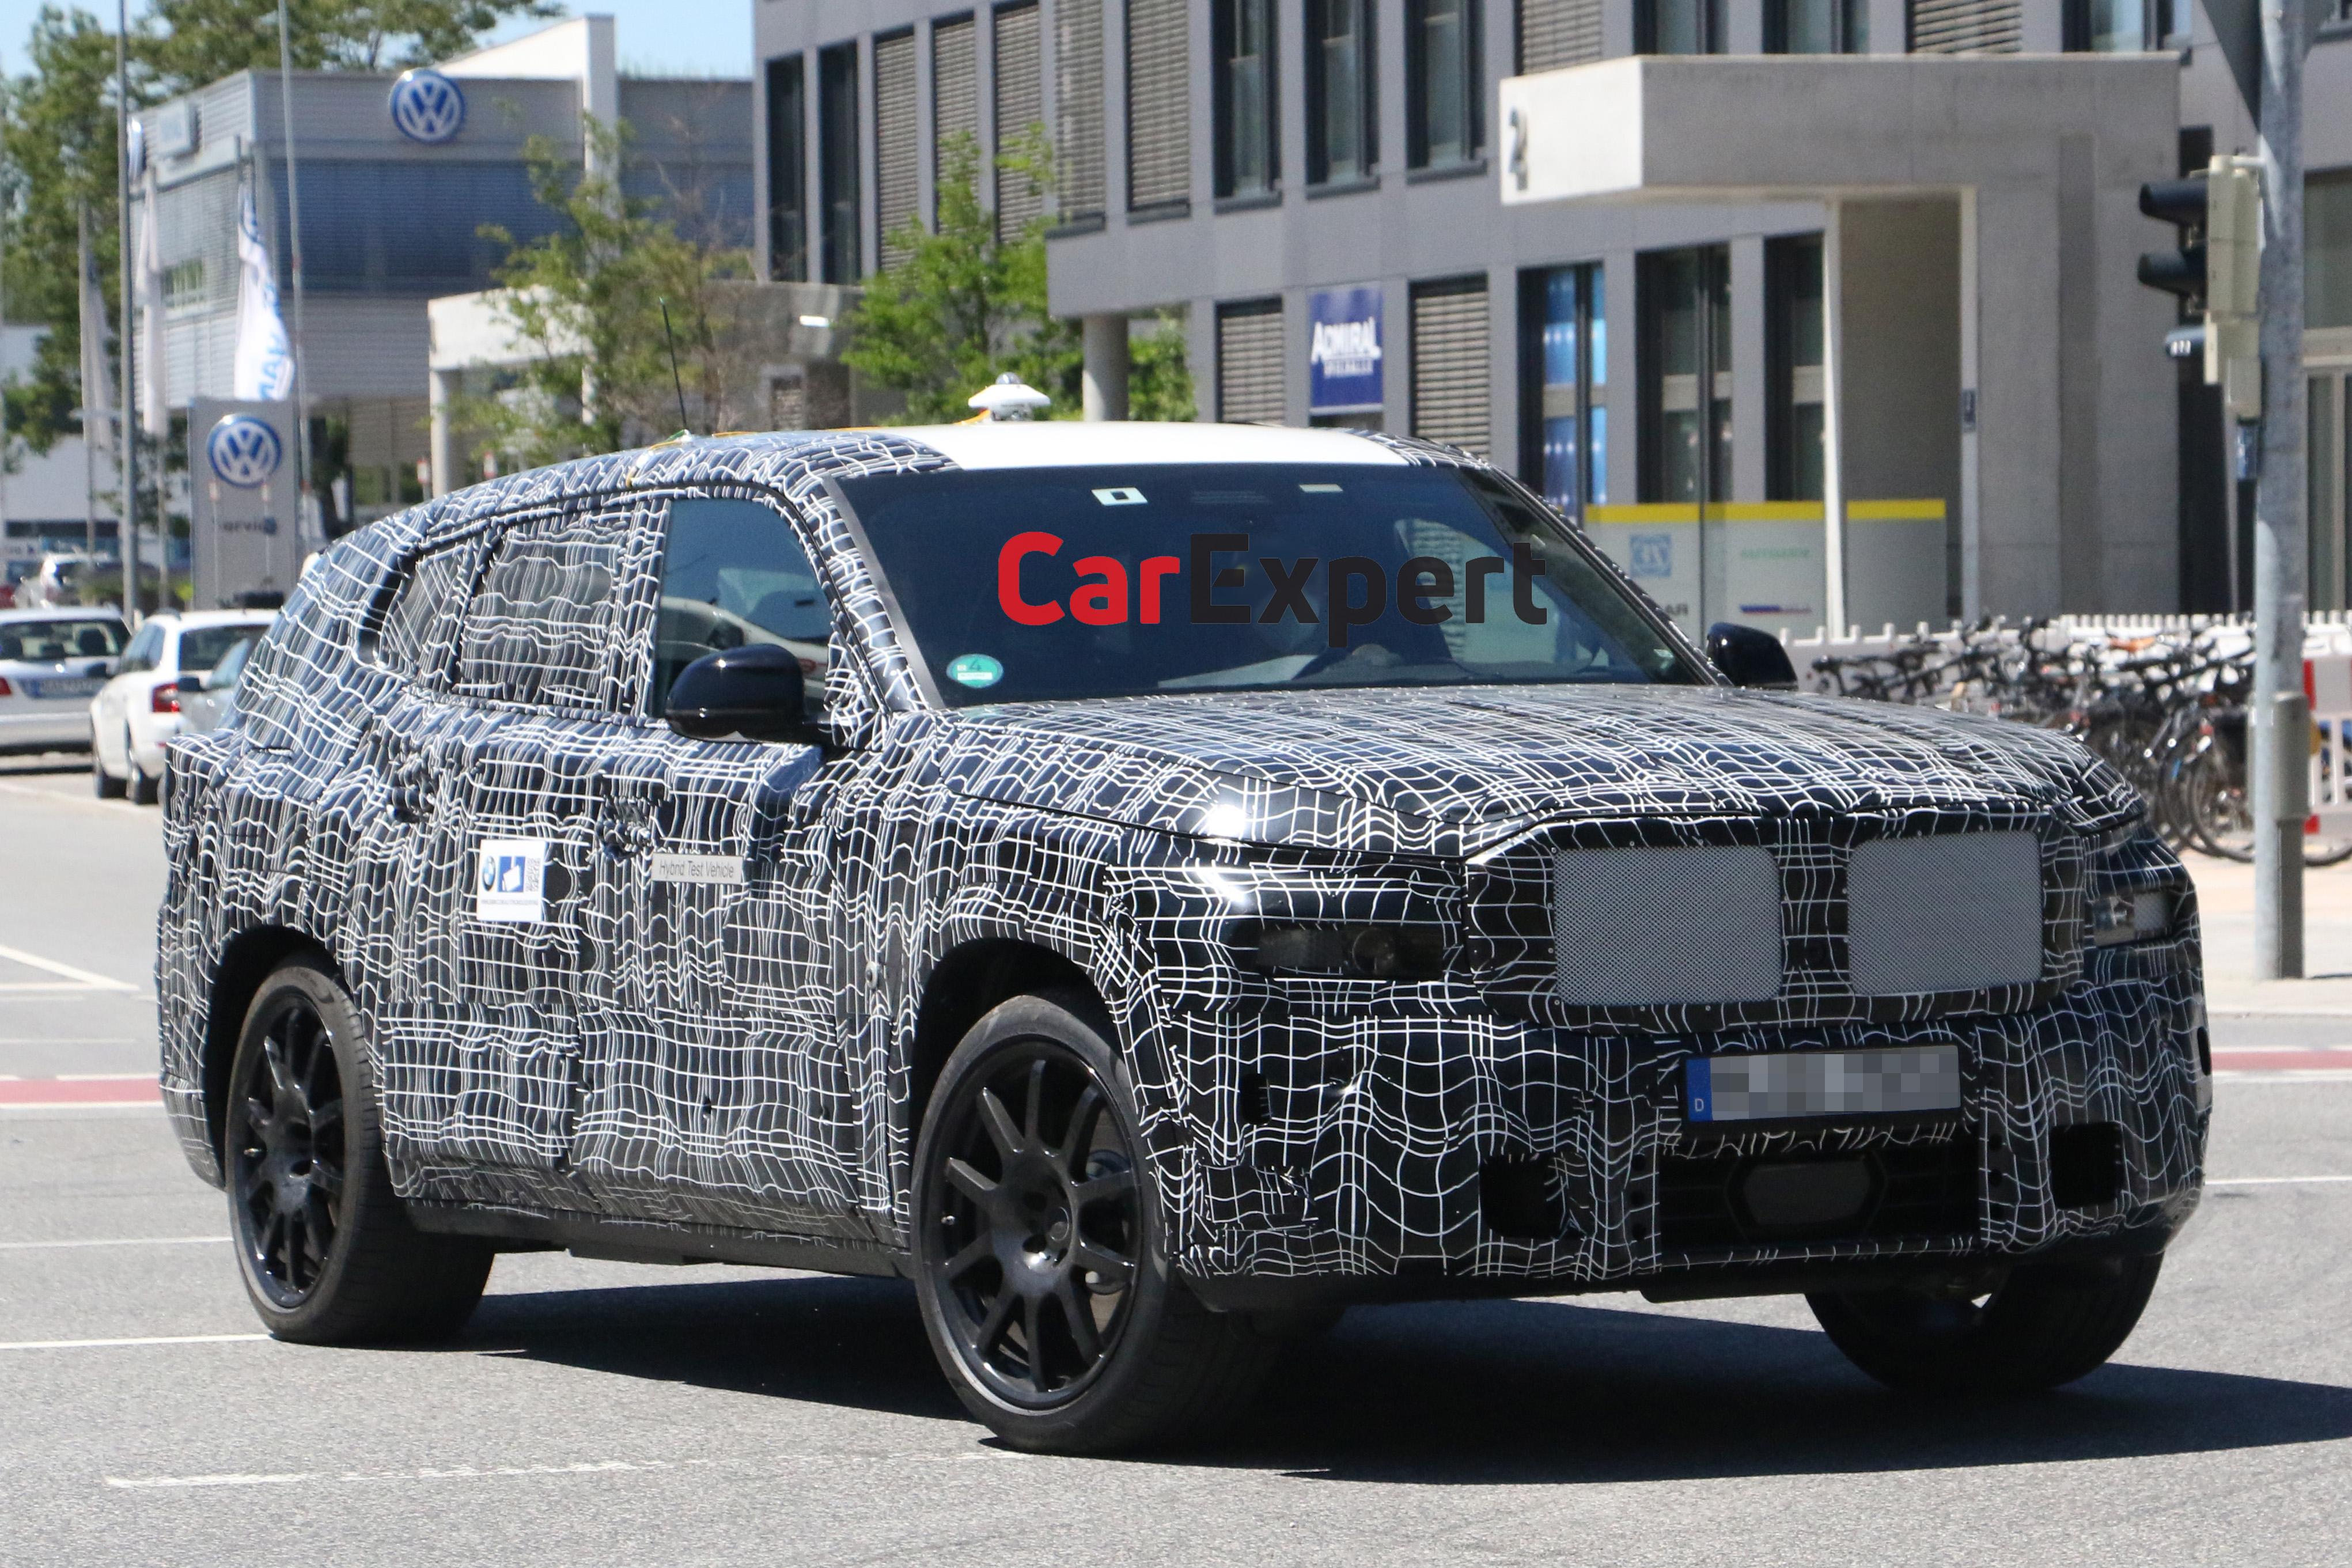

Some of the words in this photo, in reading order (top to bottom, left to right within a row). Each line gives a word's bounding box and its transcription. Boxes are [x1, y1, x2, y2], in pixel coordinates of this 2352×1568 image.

[392, 71, 463, 141] VW
[210, 415, 279, 486] VW
[659, 859, 685, 878] Hybrid
[687, 860, 704, 877] Test
[706, 861, 734, 878] Vehicle
[1695, 1097, 1704, 1112] D
